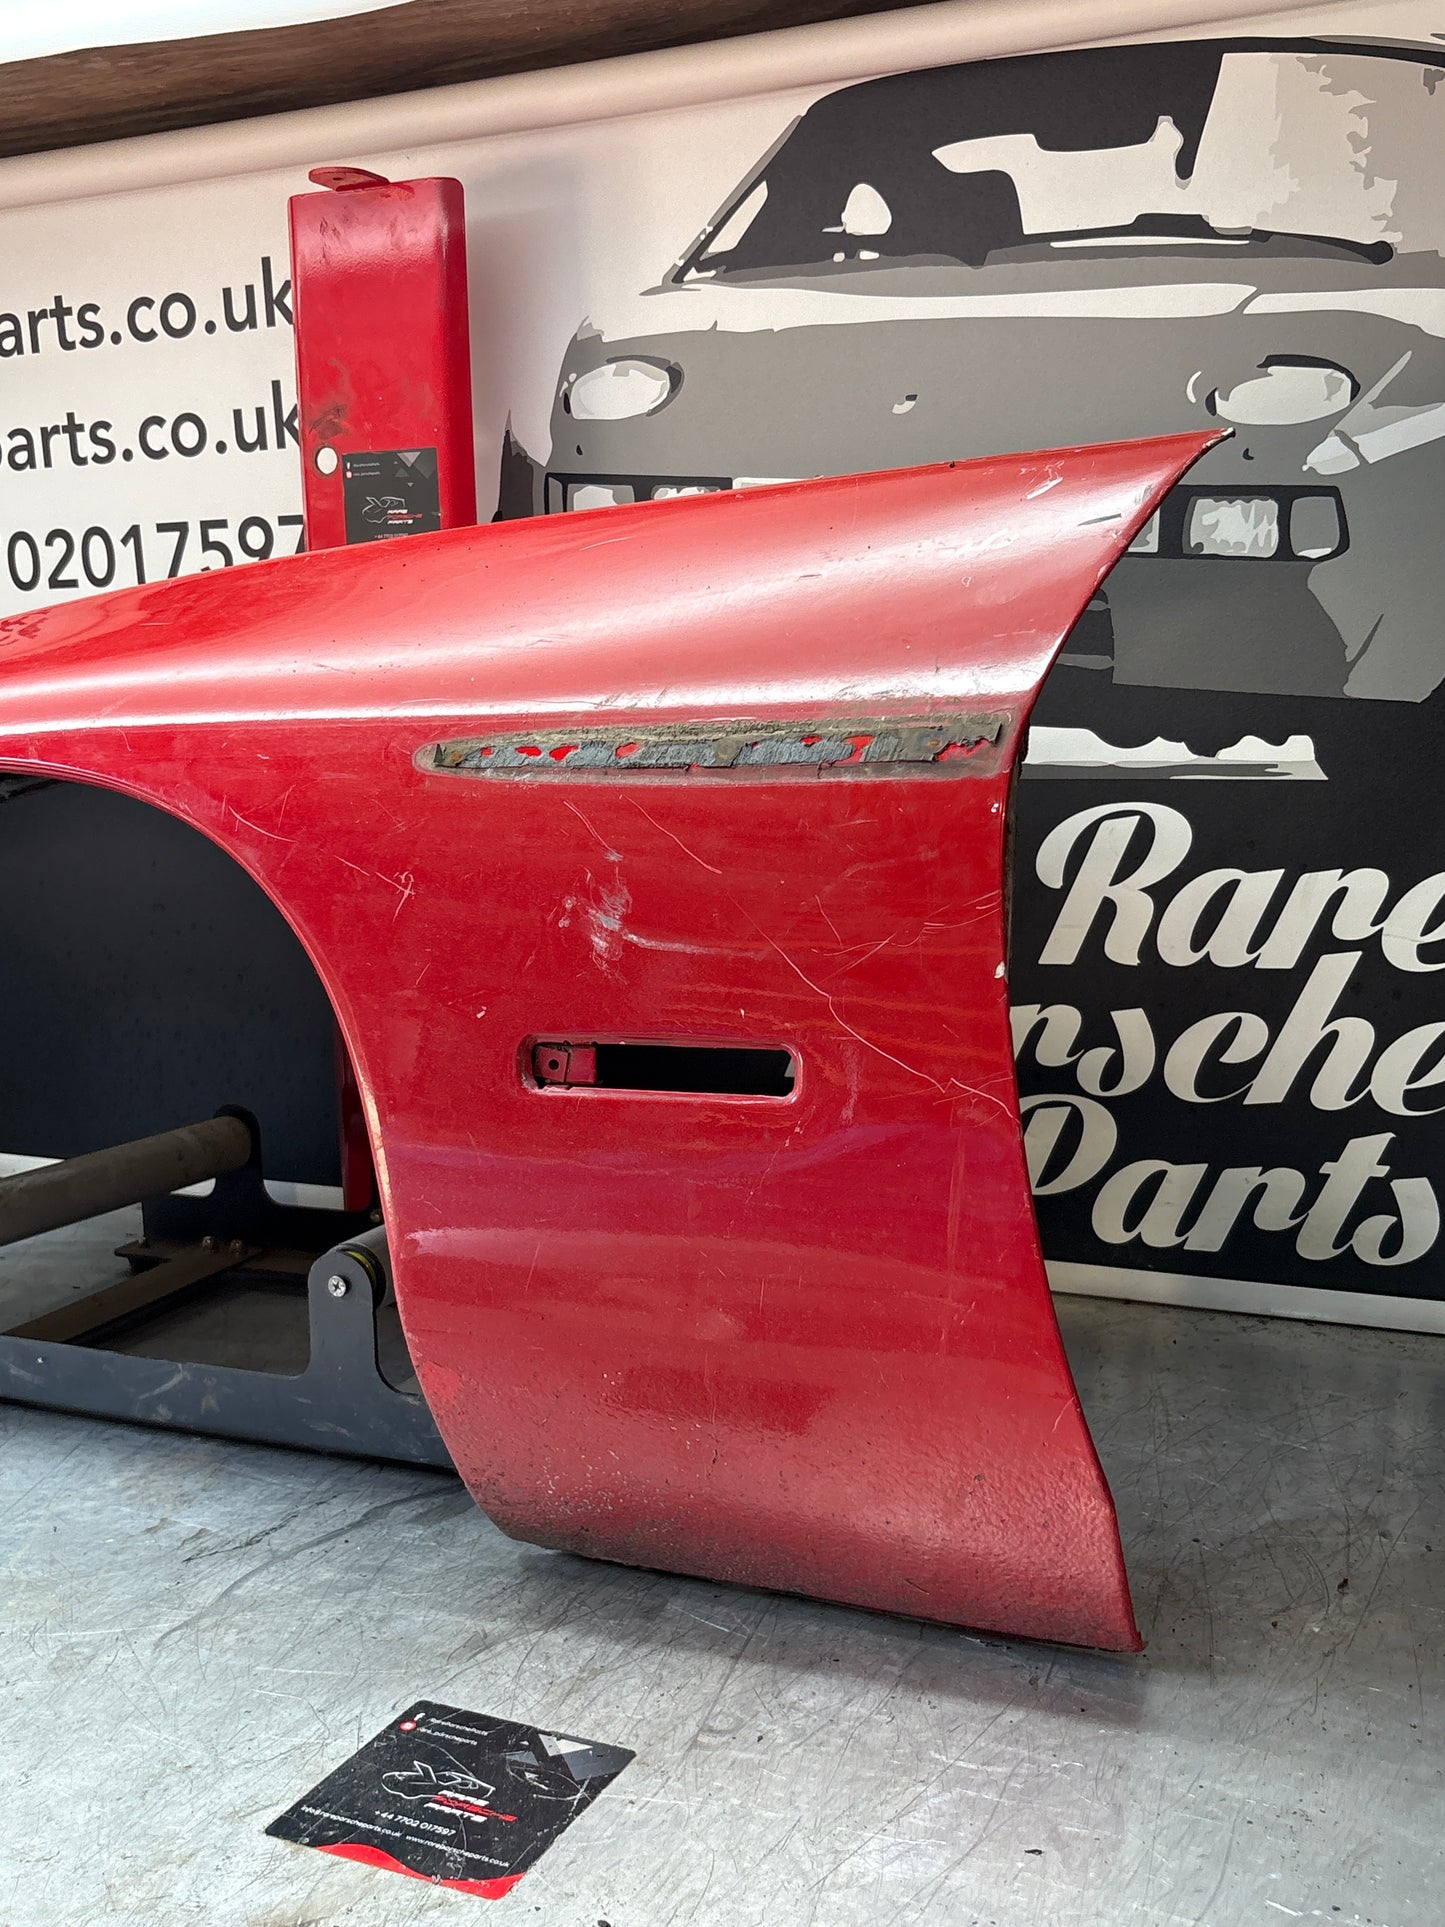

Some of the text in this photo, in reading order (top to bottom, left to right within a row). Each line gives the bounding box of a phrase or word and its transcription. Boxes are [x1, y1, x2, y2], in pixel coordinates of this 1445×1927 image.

[0, 379, 300, 471] arts.co.uk
[1035, 801, 1445, 973] Rare
[1020, 1093, 1441, 1266] Parts
[394, 1814, 420, 1828] 7702
[419, 1822, 457, 1837] 017597
[424, 1802, 488, 1823] PARTS
[438, 1789, 490, 1806] RARE
